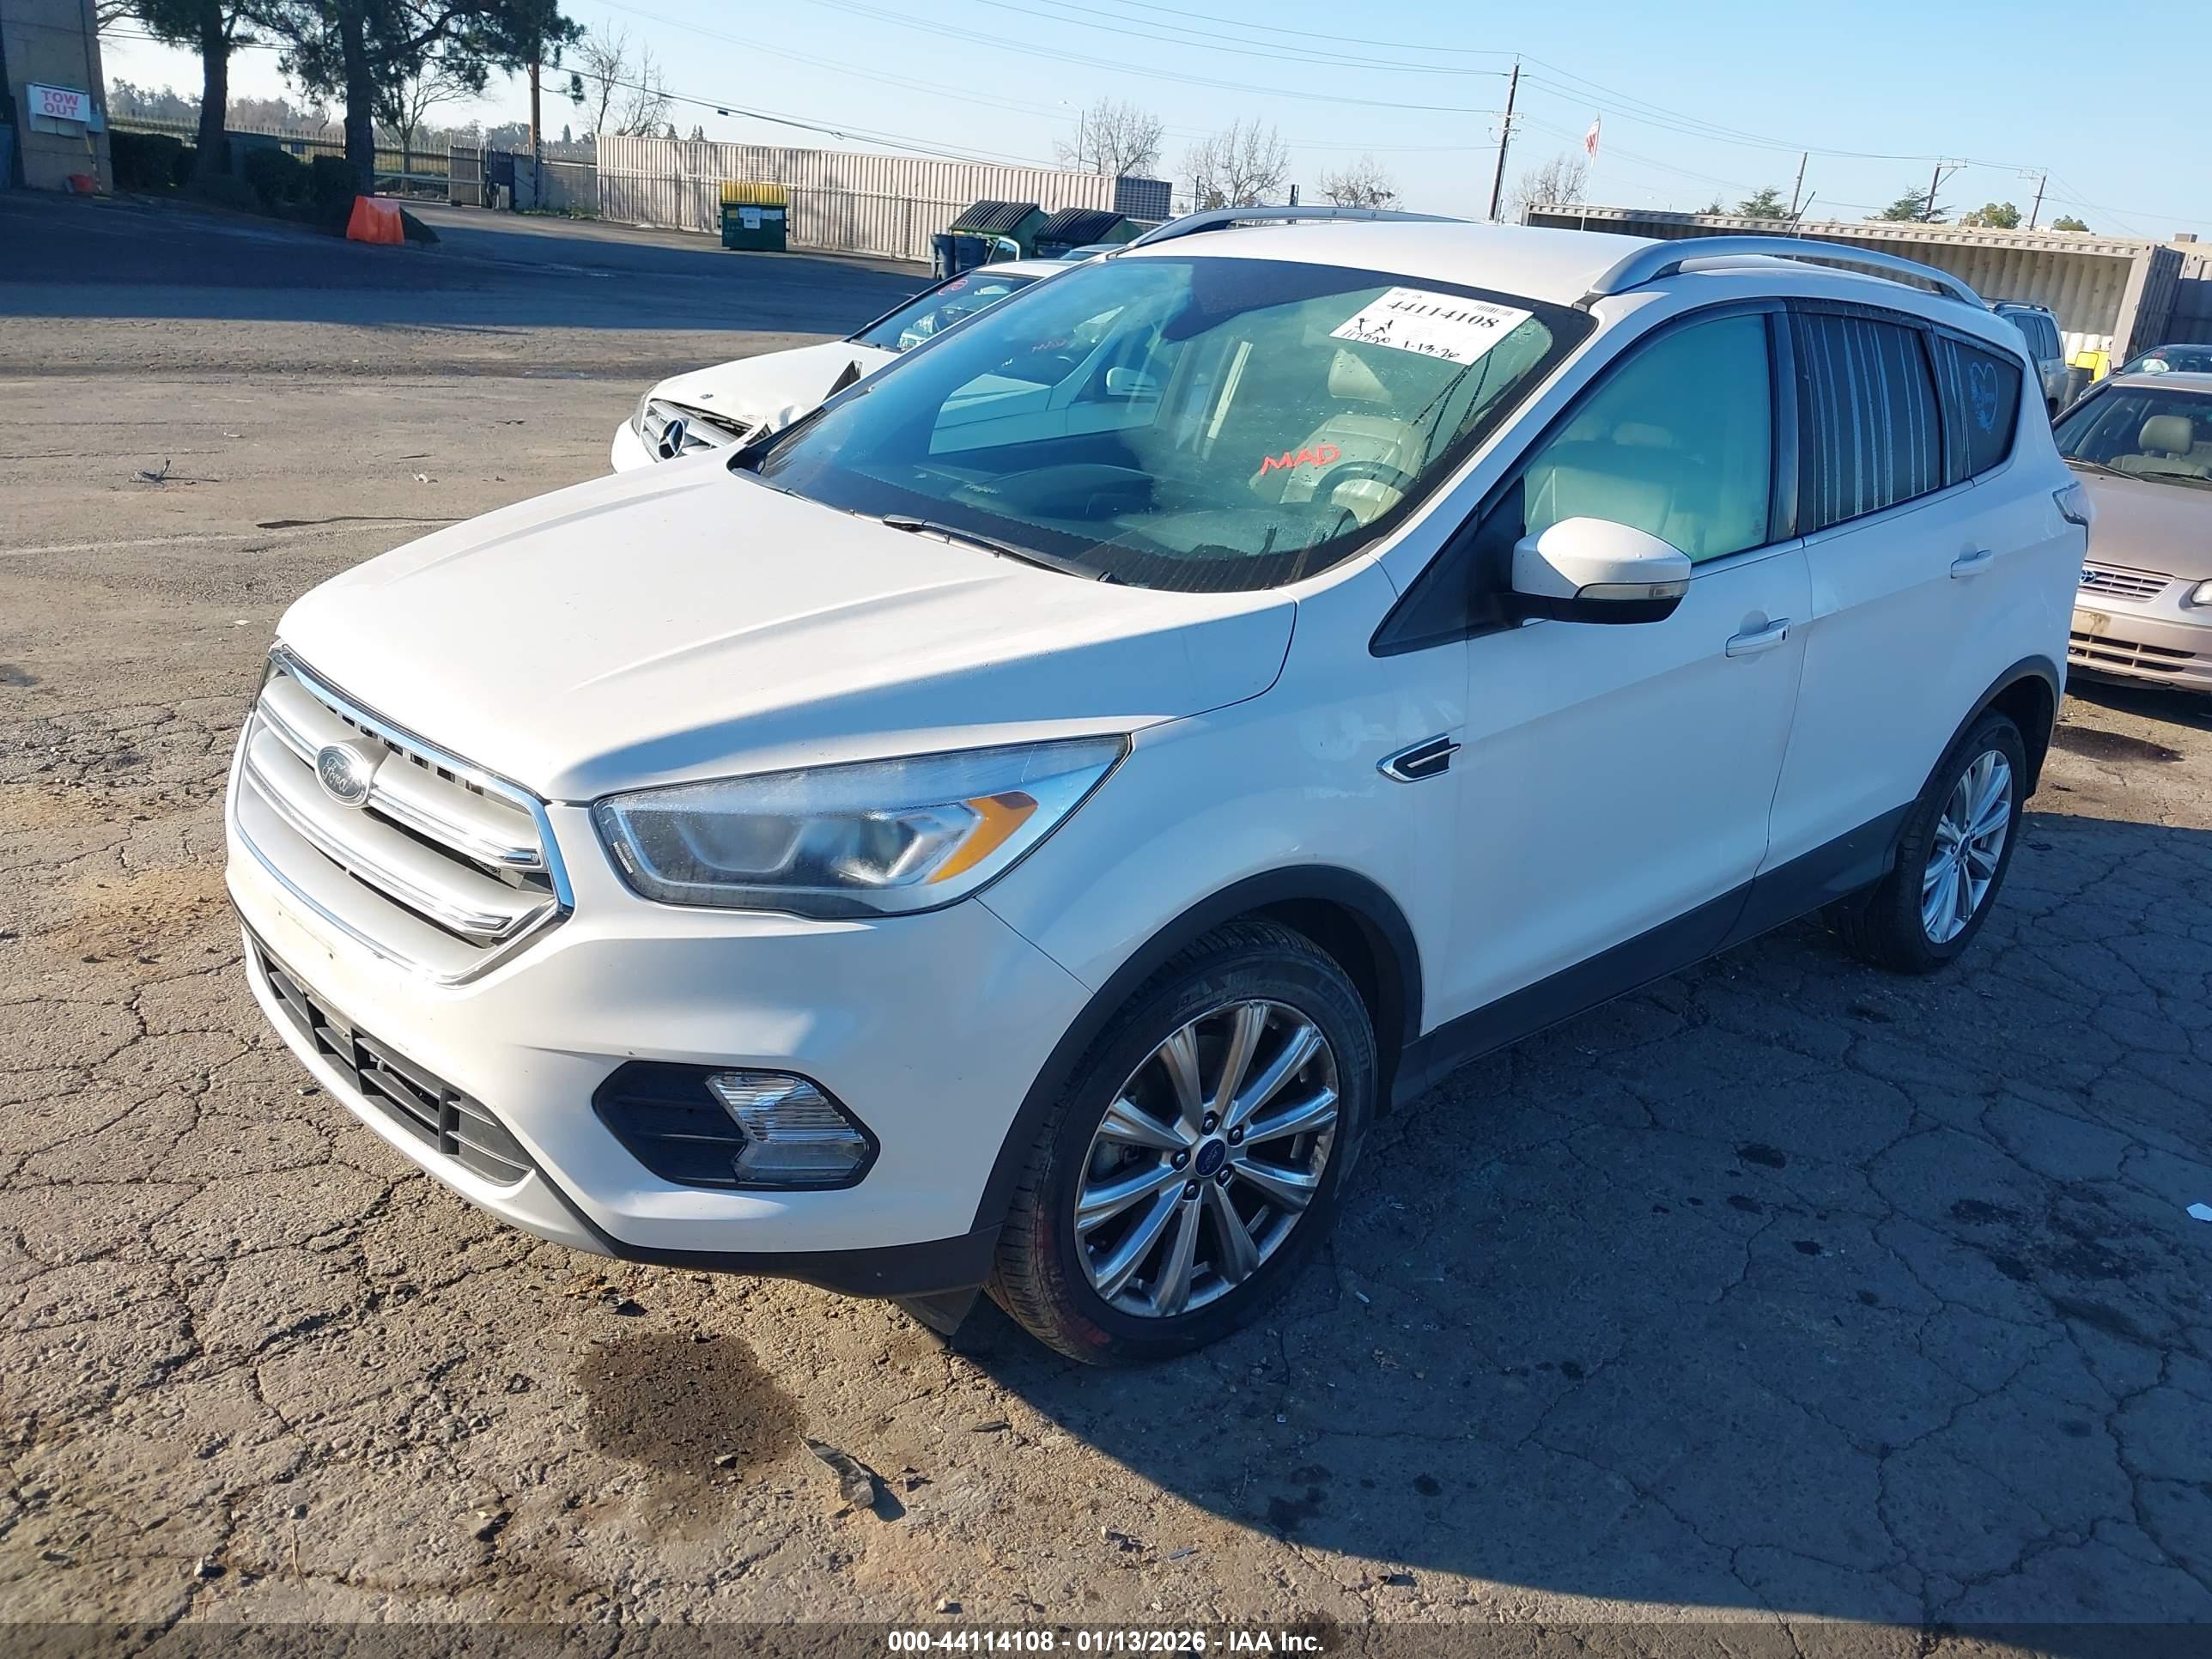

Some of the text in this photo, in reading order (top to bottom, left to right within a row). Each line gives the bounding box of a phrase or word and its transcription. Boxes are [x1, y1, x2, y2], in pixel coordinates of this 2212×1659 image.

[41, 89, 78, 106] TOW
[44, 102, 78, 117] OUT
[1386, 301, 1500, 328] 44114108
[1260, 444, 1341, 476] MAD
[321, 756, 353, 793] Ford
